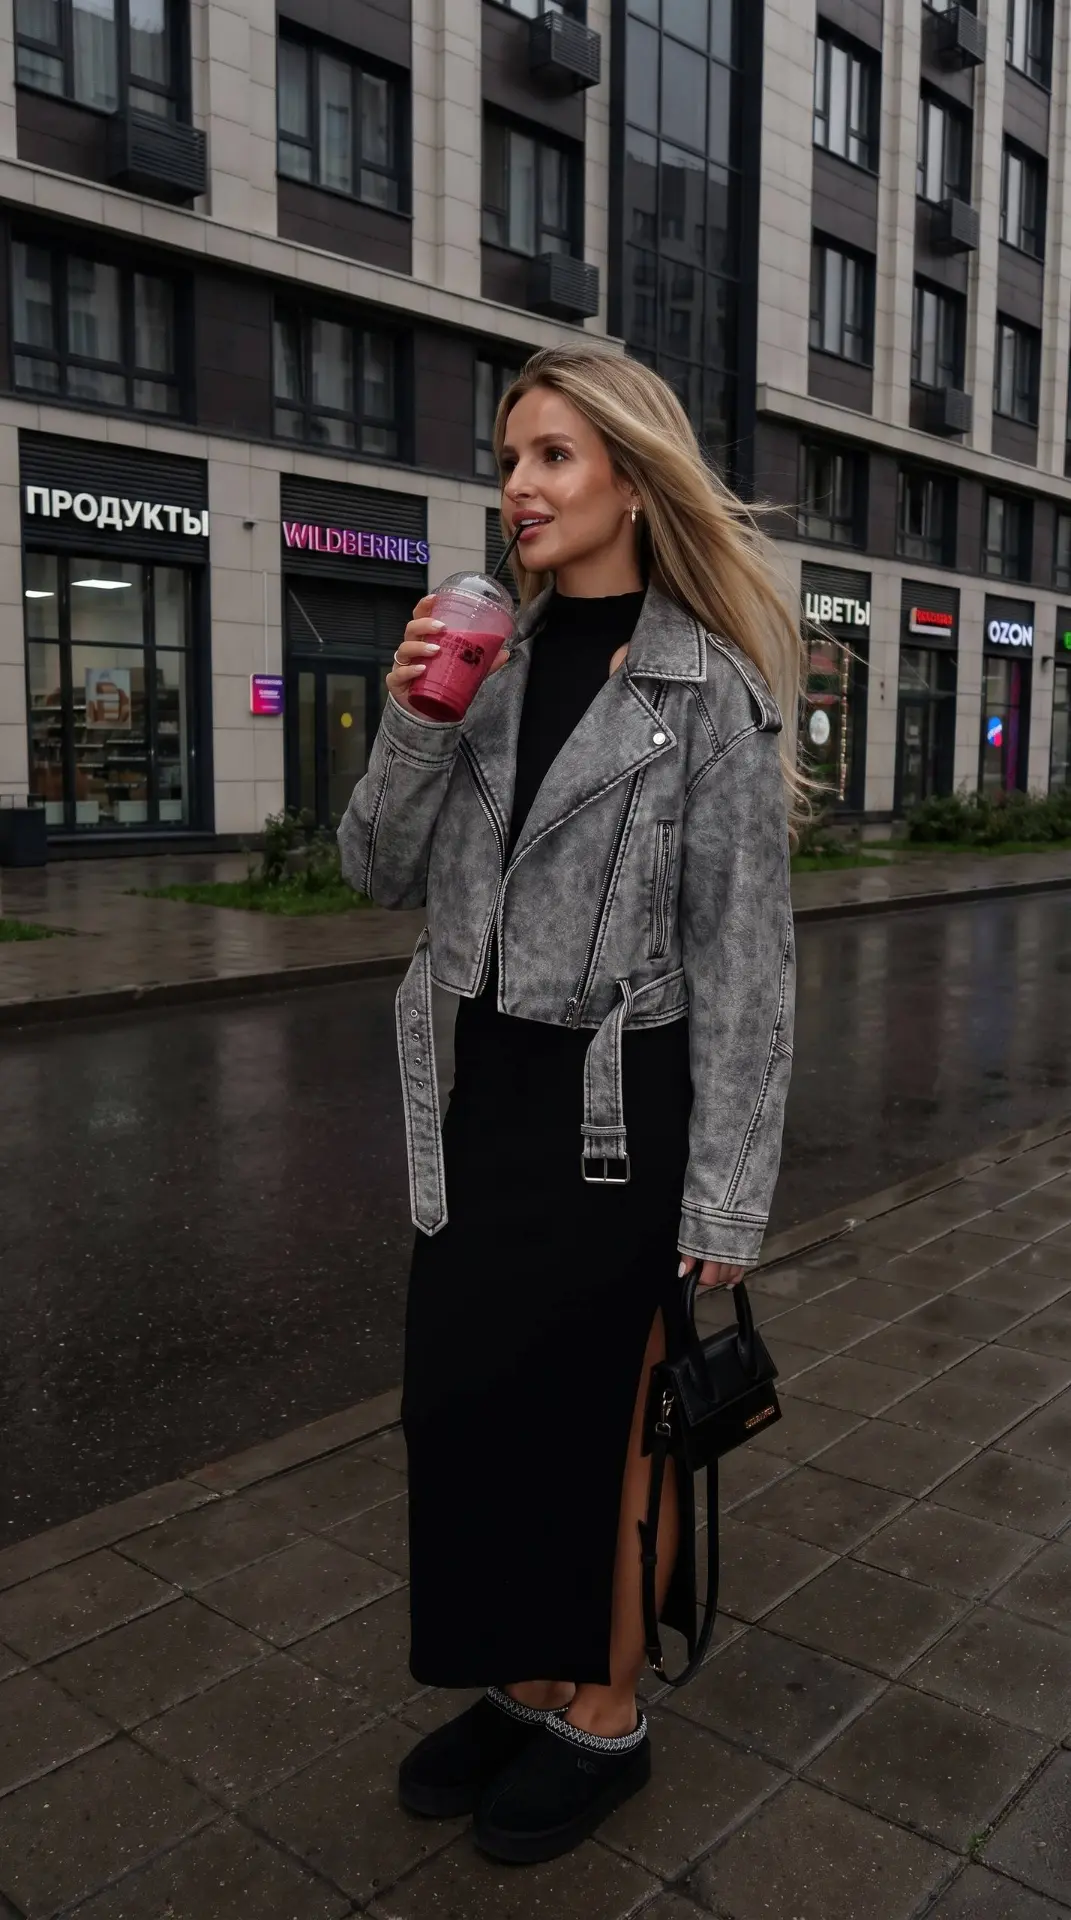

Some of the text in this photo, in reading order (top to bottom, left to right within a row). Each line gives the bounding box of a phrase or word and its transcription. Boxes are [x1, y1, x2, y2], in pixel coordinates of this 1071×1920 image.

[26, 485, 209, 537] ПРОДУКТЫ
[283, 521, 430, 565] WILDBERRIES
[805, 592, 870, 626] ЦВЕТЫ
[988, 620, 1033, 647] OZON
